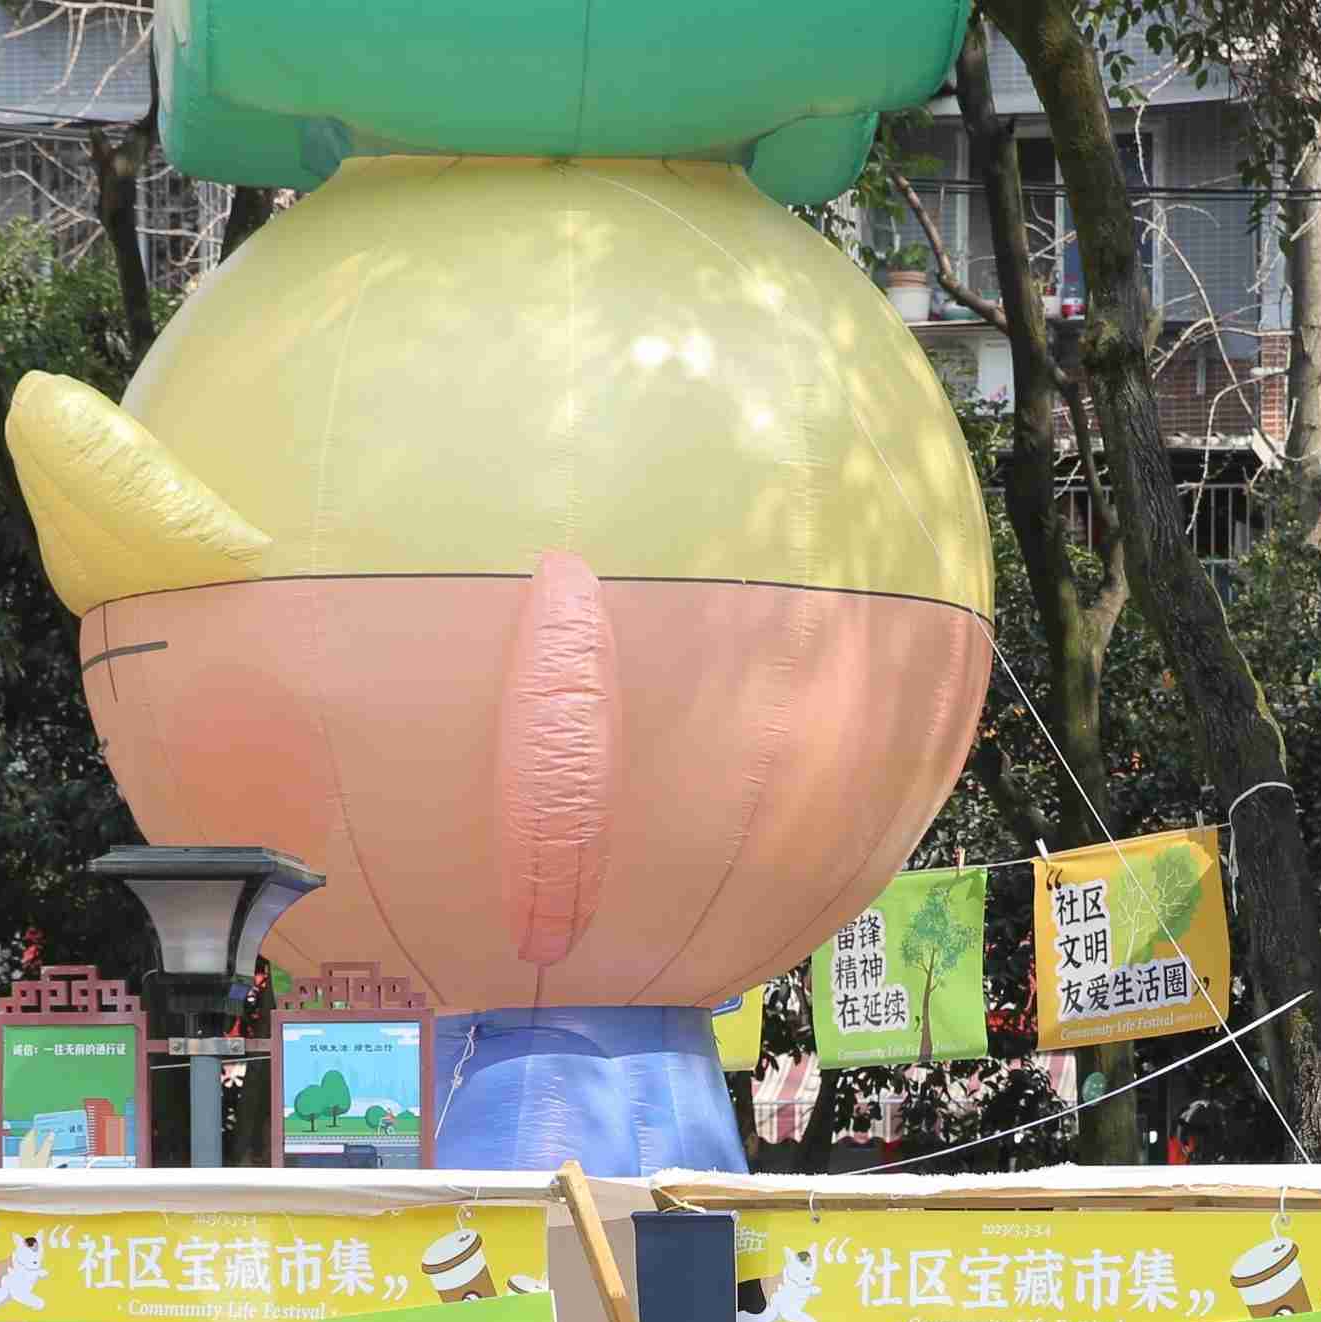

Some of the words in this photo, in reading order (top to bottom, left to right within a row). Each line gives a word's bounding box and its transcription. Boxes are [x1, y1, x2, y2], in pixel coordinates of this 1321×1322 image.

[1058, 929, 1108, 969] 文明
[835, 954, 884, 990] 精神
[128, 1299, 222, 1320] Community
[228, 1300, 258, 1319] Life
[262, 1302, 327, 1320] Festival
